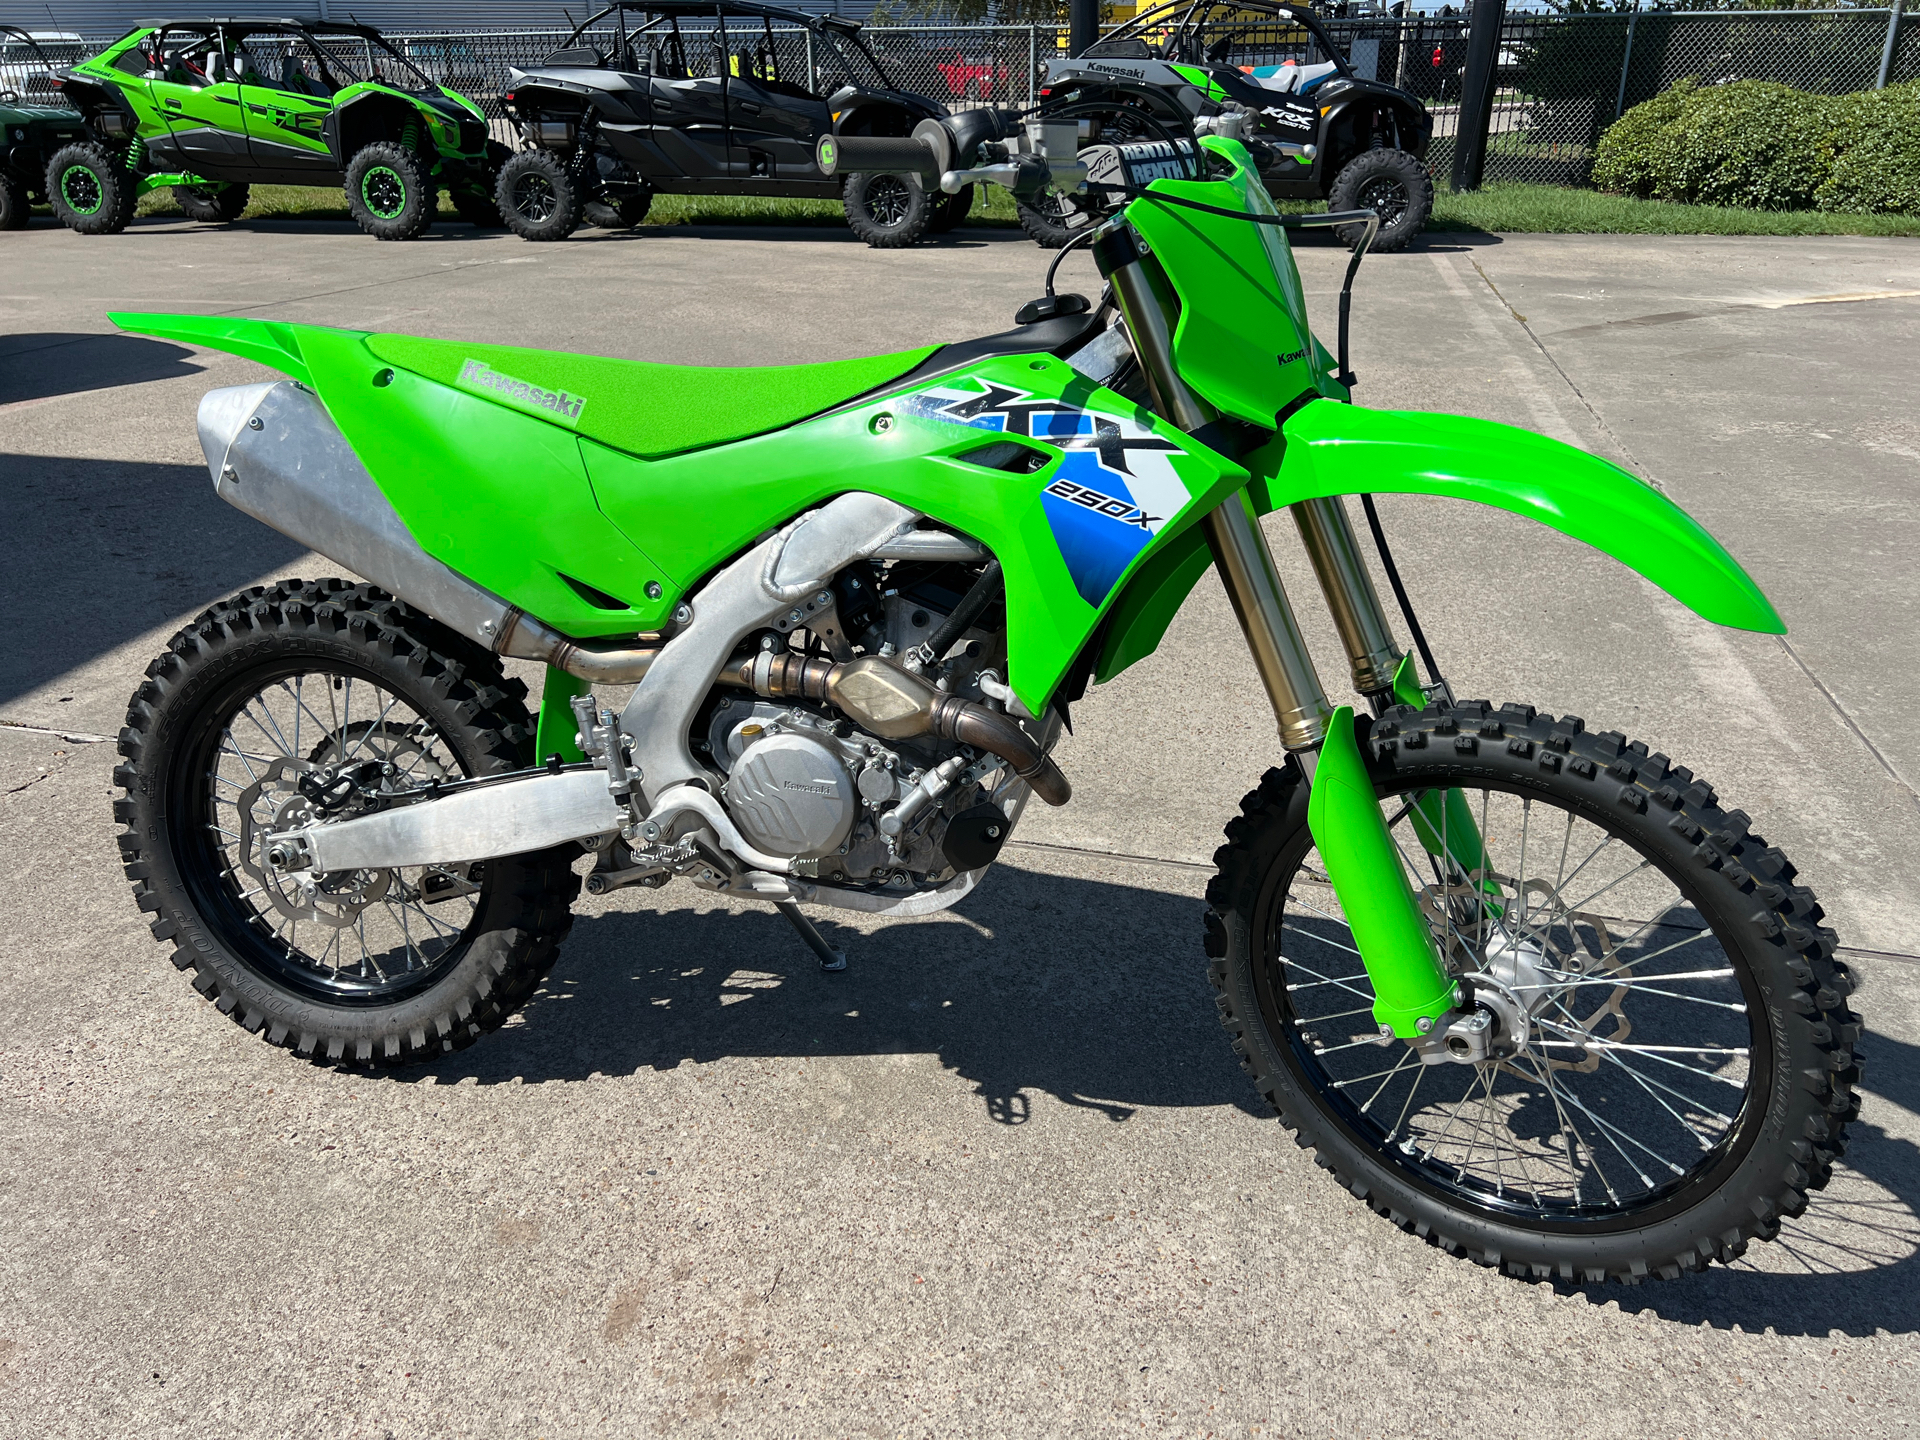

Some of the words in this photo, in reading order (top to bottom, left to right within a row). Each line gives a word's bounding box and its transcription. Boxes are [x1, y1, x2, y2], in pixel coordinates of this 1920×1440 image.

[1087, 62, 1145, 79] Kawasaki
[1260, 105, 1314, 126] KRX
[461, 360, 583, 418] Kawasaki
[1044, 480, 1164, 530] 250X
[784, 780, 831, 795] Kawasaki
[172, 909, 294, 1016] DUNLOP
